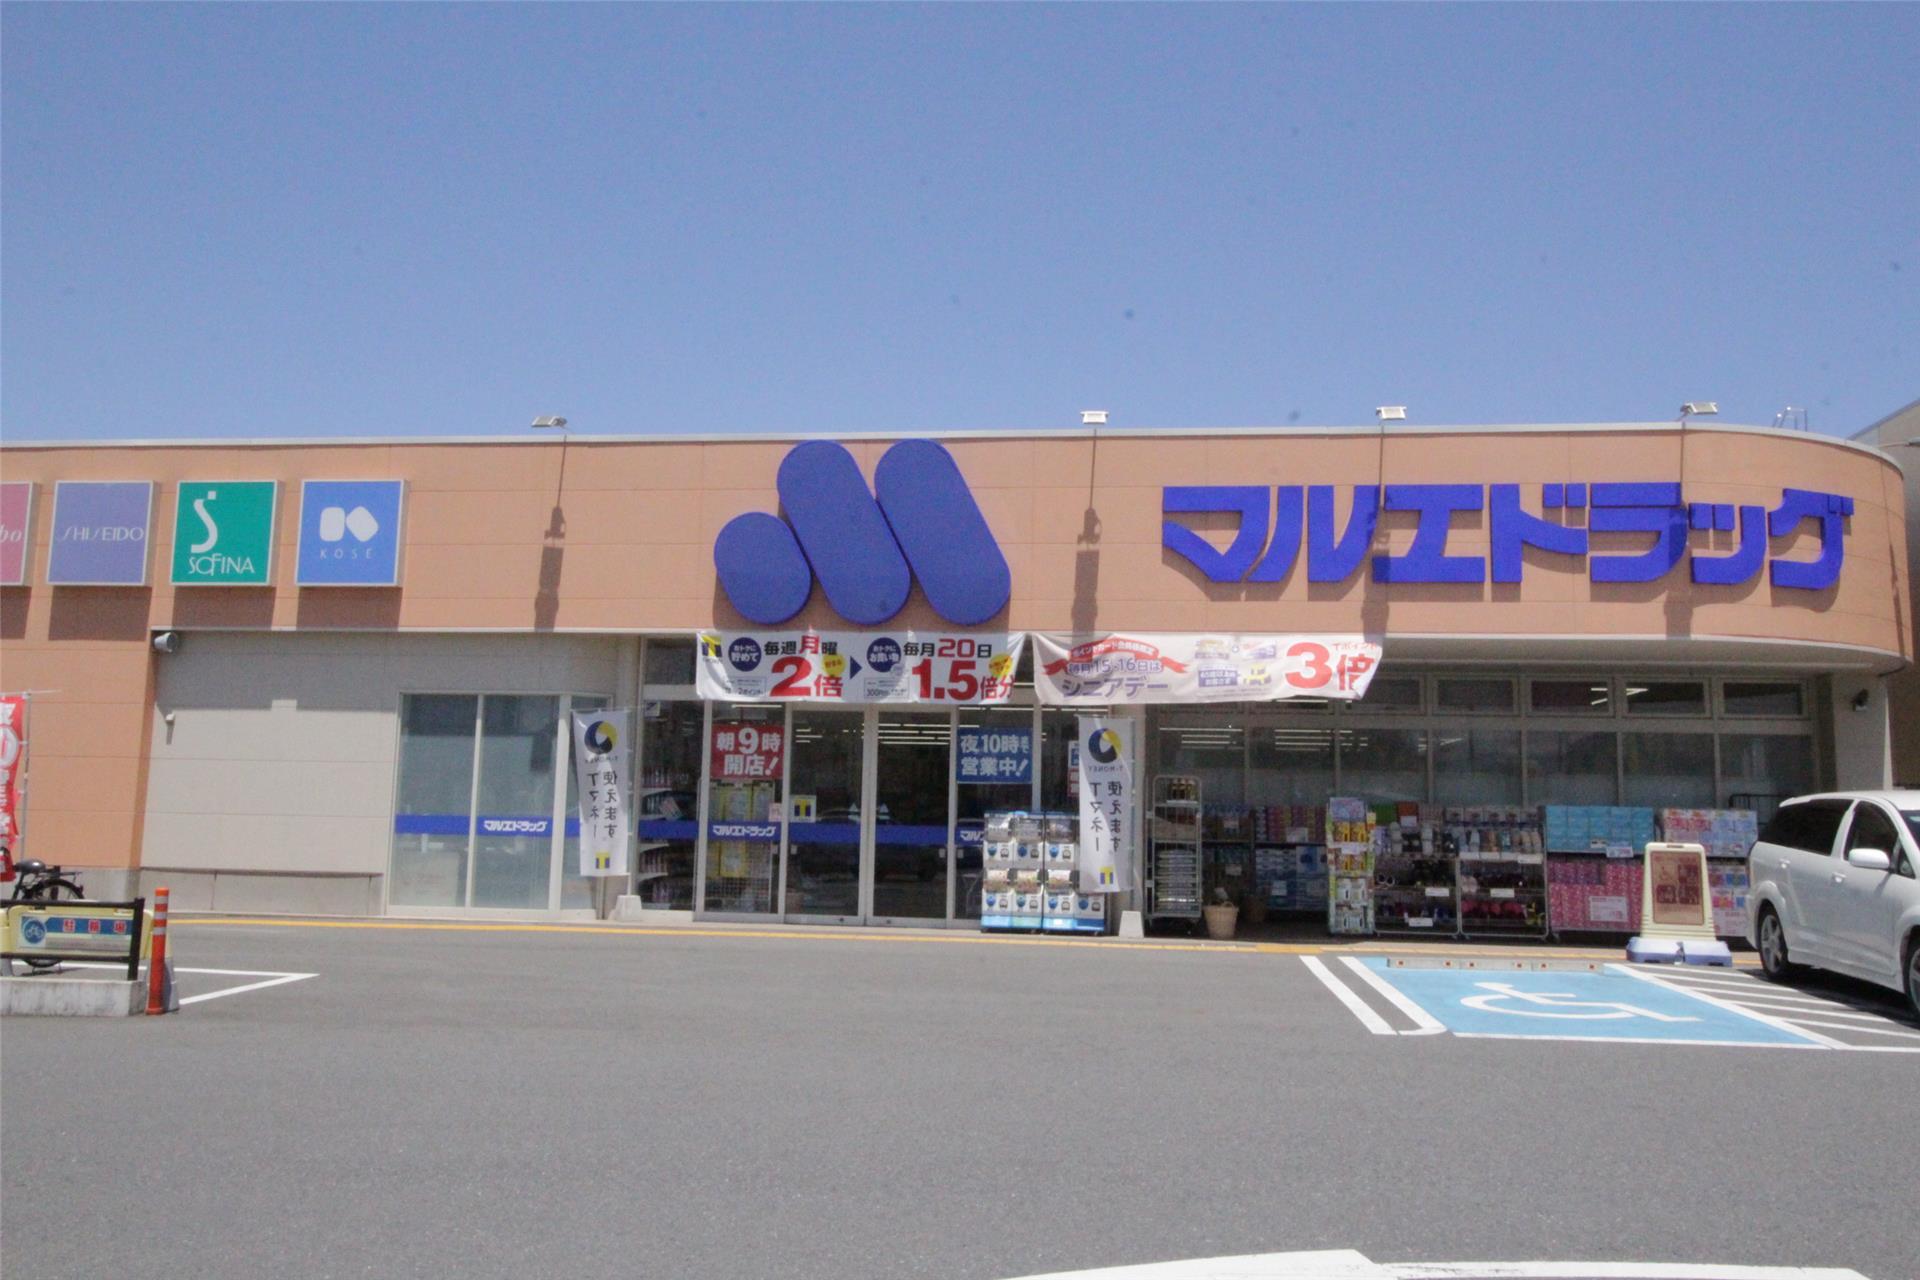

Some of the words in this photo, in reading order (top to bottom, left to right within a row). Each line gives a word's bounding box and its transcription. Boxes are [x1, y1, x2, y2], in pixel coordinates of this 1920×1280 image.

[57, 526, 144, 542] SHISEIDO
[1162, 482, 1854, 591] マルエドラッグ
[188, 553, 255, 576] SOFINA
[903, 638, 992, 658] 毎月20日
[1062, 675, 1168, 698] シニアデー
[717, 727, 781, 754] 朝9時
[484, 820, 548, 833] マルエドラッグ
[712, 825, 776, 837] マルエドラッグ
